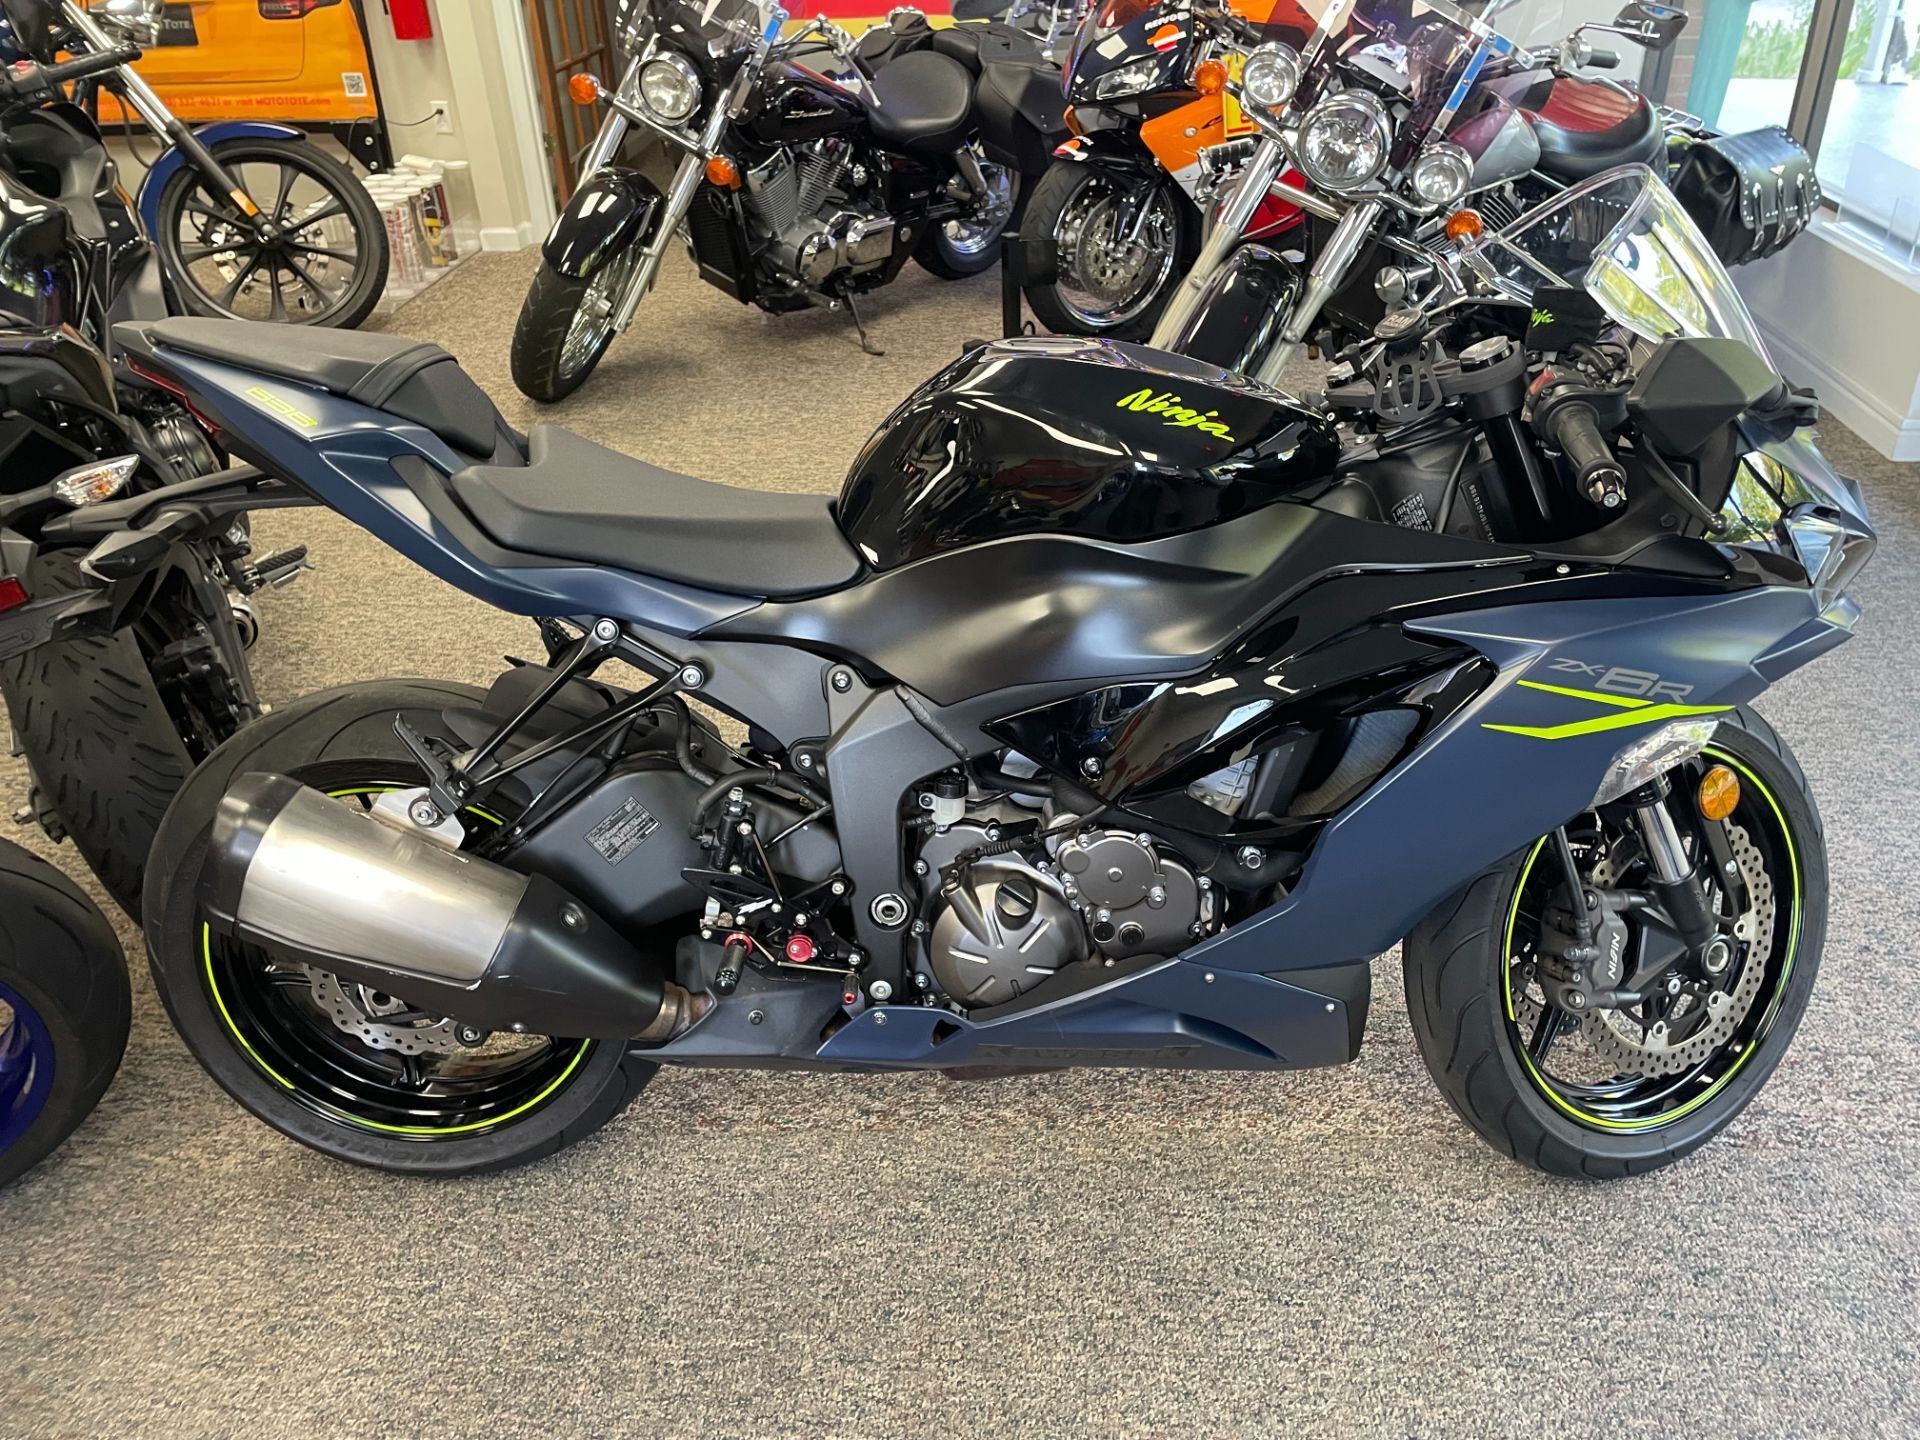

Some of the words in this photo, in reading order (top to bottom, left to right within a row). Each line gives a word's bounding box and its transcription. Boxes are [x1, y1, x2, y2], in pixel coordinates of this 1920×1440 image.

[1531, 308, 1555, 328] inja
[245, 386, 318, 428] 636
[1116, 388, 1235, 442] Ninja
[1548, 657, 1695, 705] ZX-6R
[1607, 931, 1621, 980] NISSIN
